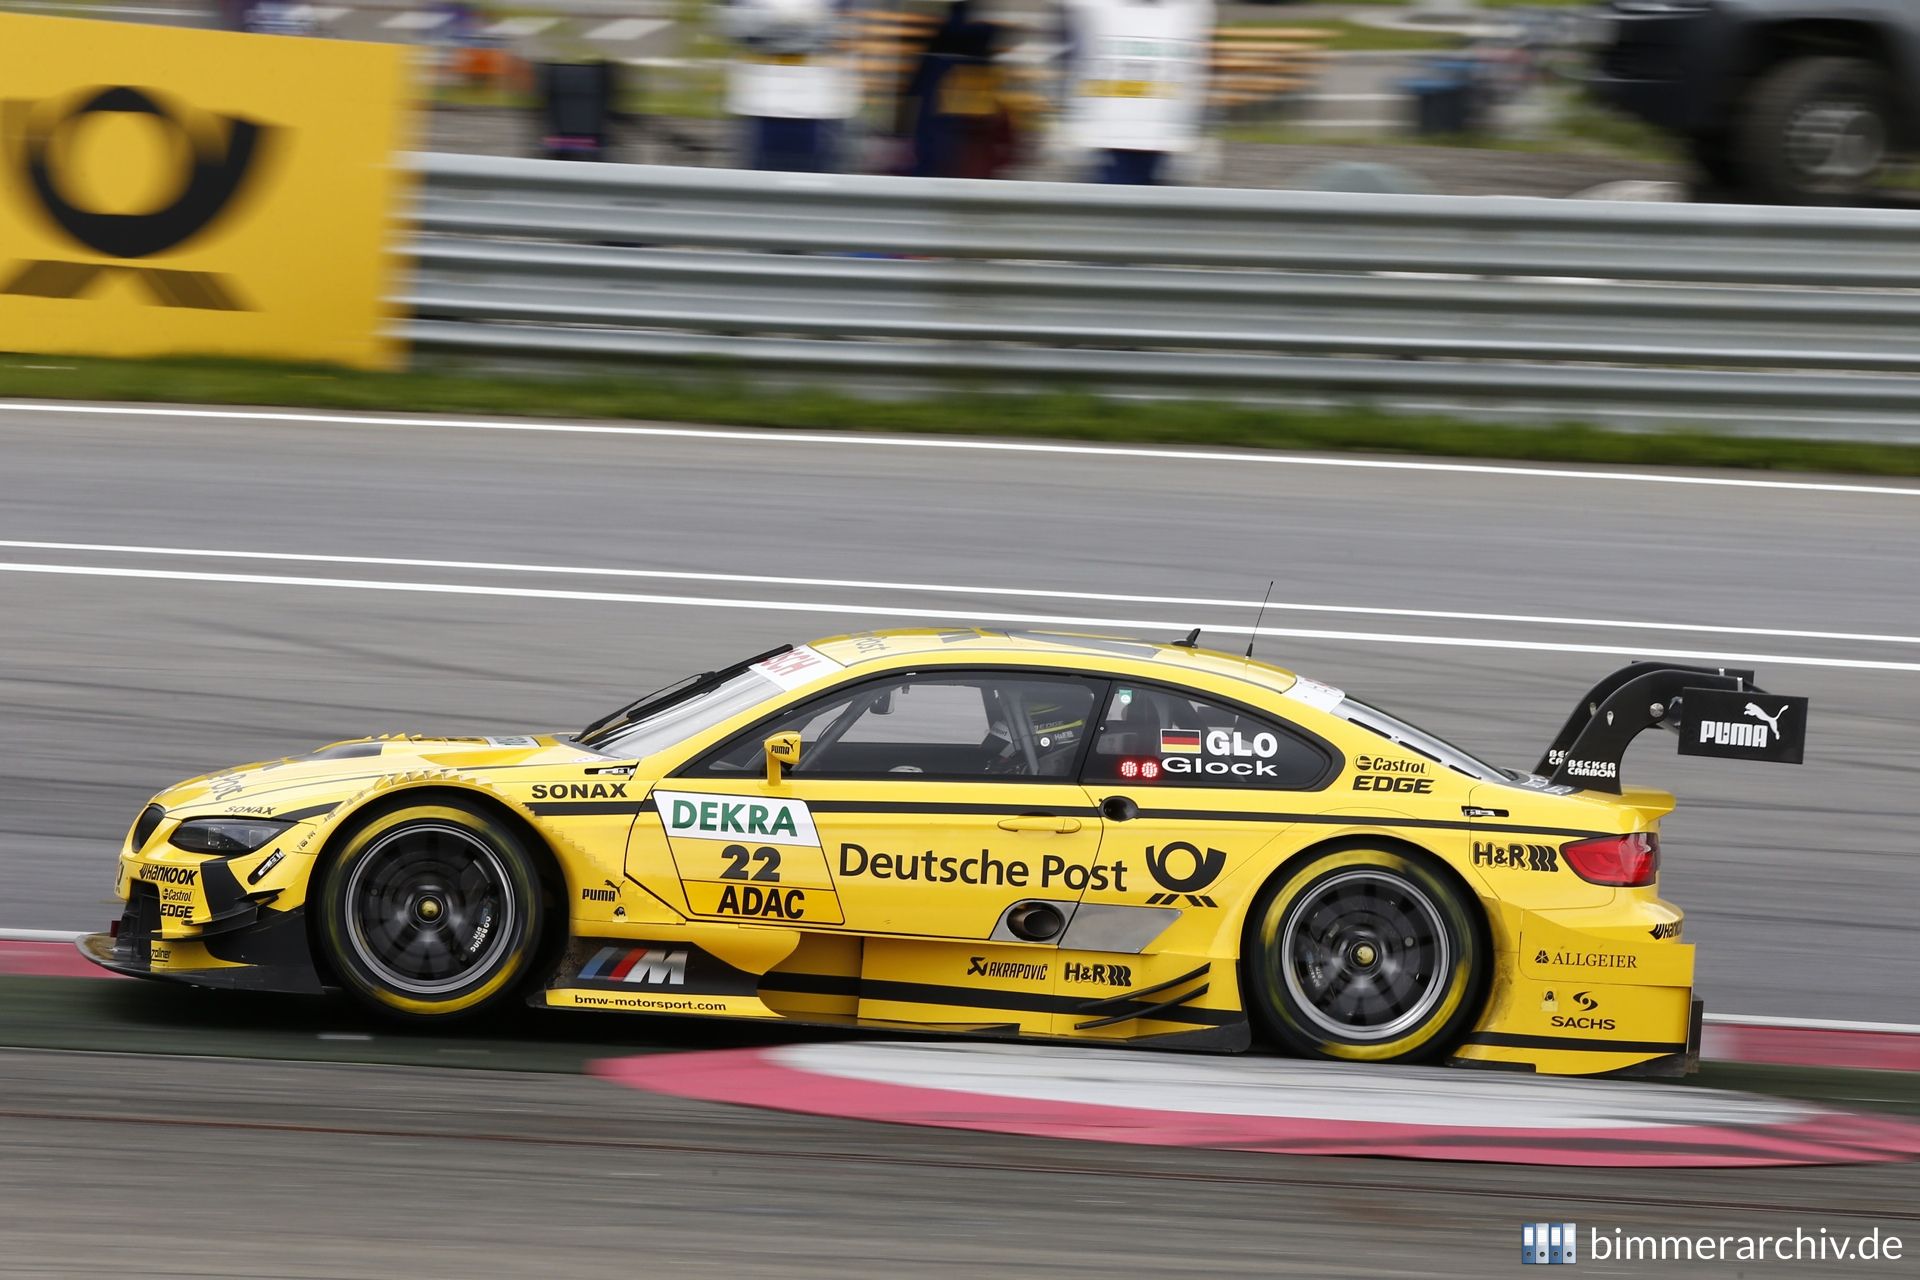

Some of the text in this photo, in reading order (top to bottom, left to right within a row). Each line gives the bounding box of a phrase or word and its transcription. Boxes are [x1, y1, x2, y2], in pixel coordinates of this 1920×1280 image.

[1700, 720, 1768, 748] PUMA
[771, 745, 790, 755] PUMA
[1206, 730, 1278, 758] GLO
[1161, 757, 1278, 777] Glock
[1373, 757, 1426, 774] Castrol
[1567, 759, 1616, 771] BECKER
[1567, 767, 1616, 778] CARBON
[531, 783, 628, 799] SONAX
[1352, 775, 1436, 794] EDGE
[224, 806, 276, 815] SONAX
[672, 800, 798, 837] DEKRA
[719, 844, 782, 882] 22
[839, 842, 1128, 893] Deutsche Post
[168, 888, 192, 902] Castrol
[582, 888, 616, 902] PUMA
[717, 885, 805, 919] ADAC
[161, 903, 194, 918] EDGE
[1552, 952, 1638, 969] ALLGEIER
[575, 995, 727, 1011] bmw-motorsport.com
[1551, 1016, 1616, 1030] SACHS
